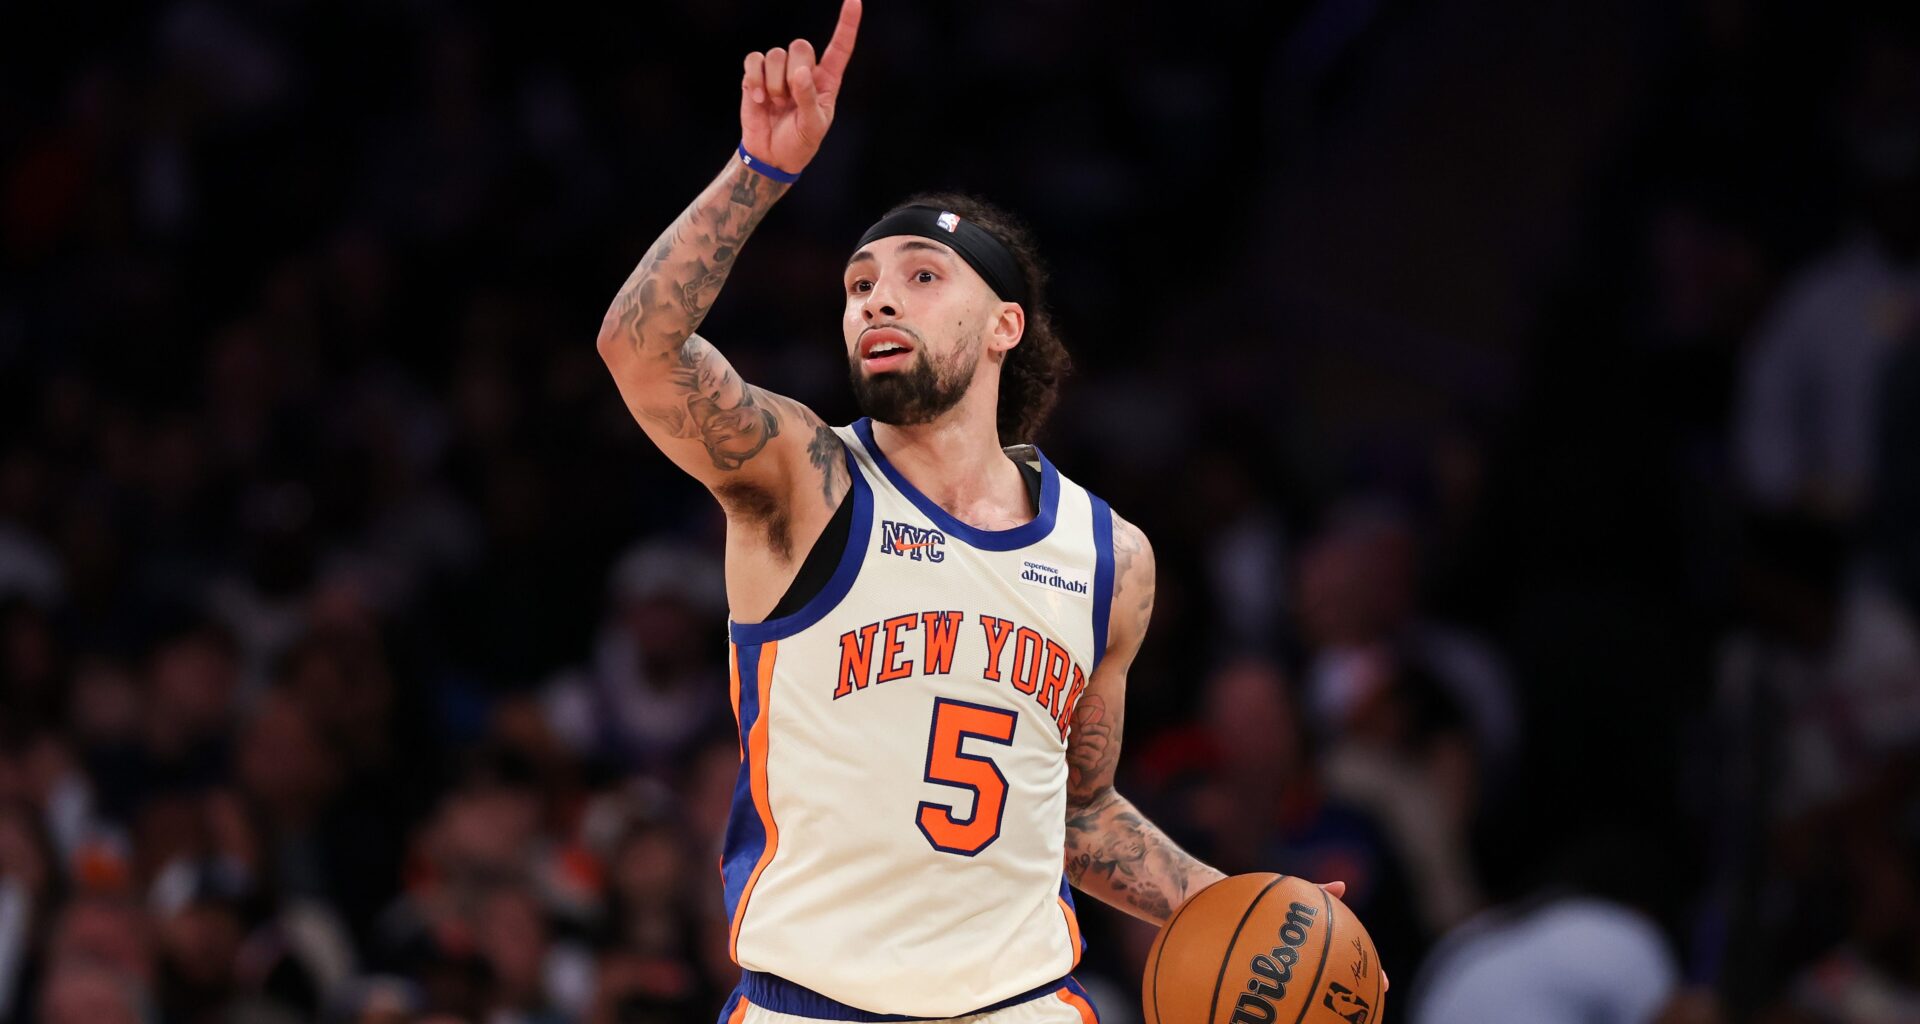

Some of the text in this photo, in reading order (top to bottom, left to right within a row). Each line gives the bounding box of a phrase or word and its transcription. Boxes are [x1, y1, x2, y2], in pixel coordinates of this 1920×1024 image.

[881, 520, 945, 563] NYC
[1021, 570, 1088, 594] abu dhabi
[1024, 561, 1058, 574] experience
[833, 611, 1085, 744] NEW YORK
[915, 696, 1019, 857] 5
